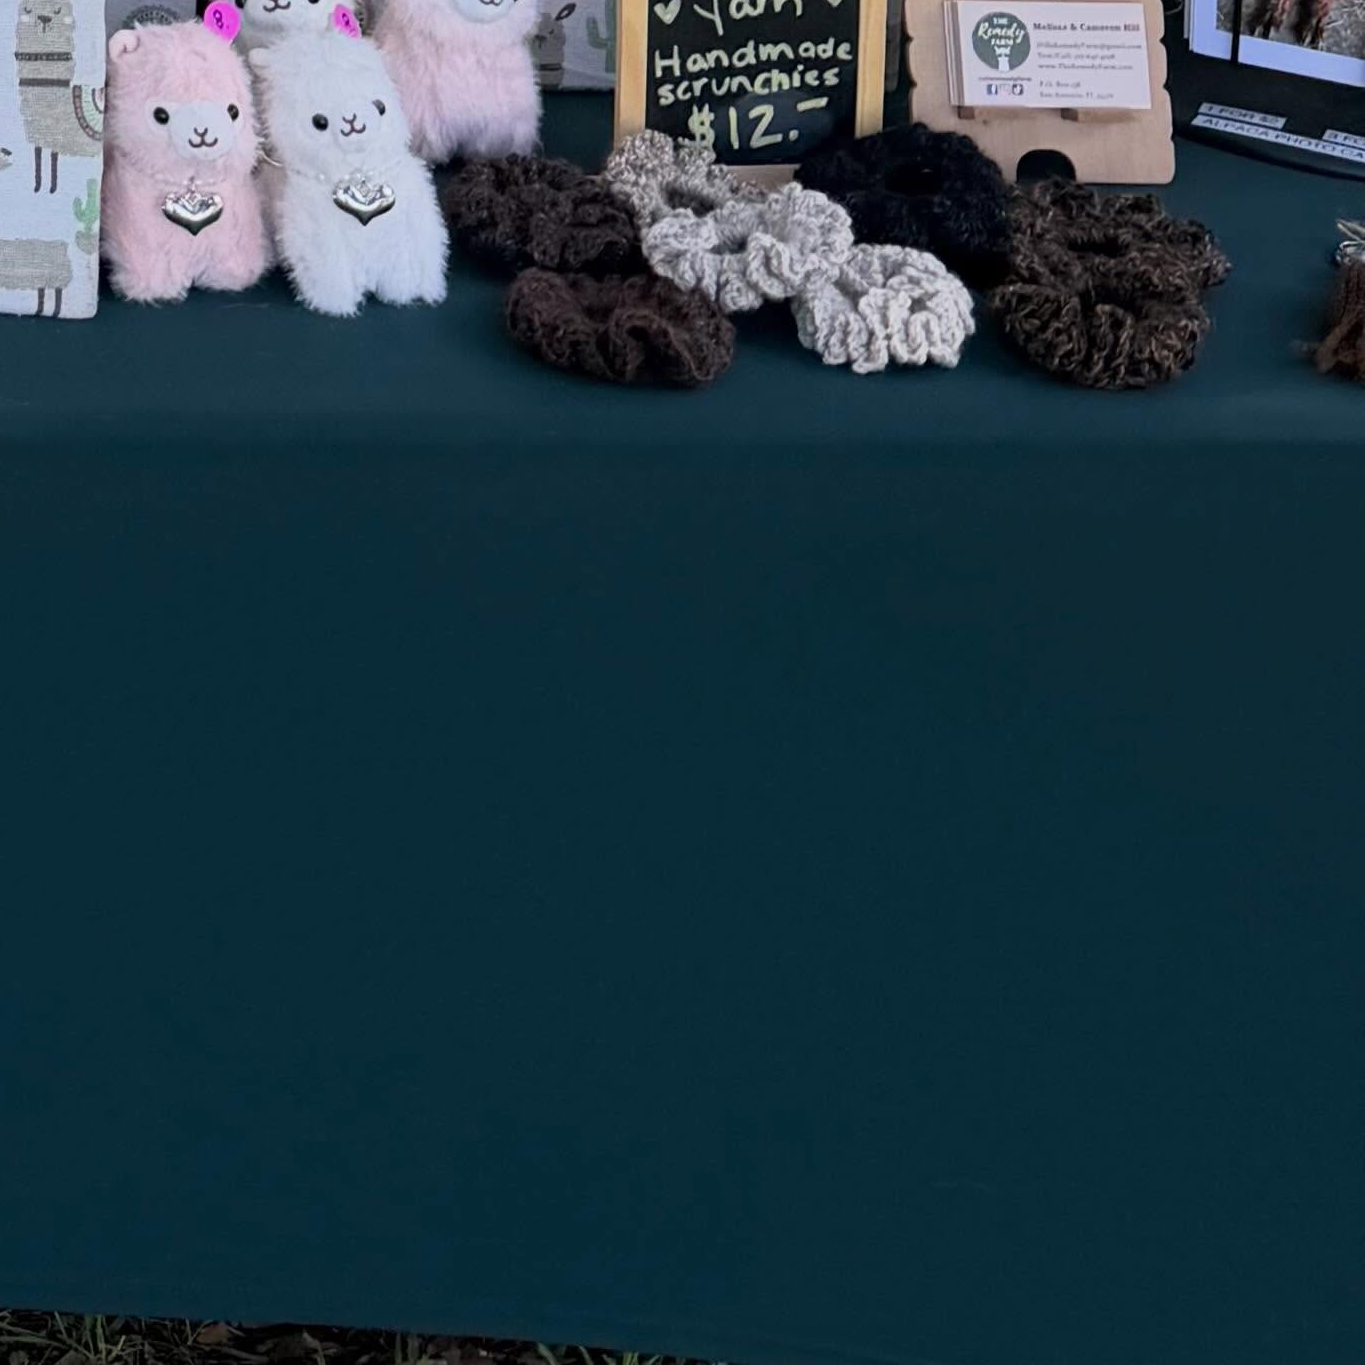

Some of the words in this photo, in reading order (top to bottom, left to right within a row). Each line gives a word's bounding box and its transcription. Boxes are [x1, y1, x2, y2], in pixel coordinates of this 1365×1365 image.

[977, 21, 1025, 44] Remedy
[654, 37, 853, 78] Handmade
[656, 65, 840, 106] scrunchies
[1202, 117, 1270, 138] ALPACA
[1273, 130, 1337, 153] PHOTO
